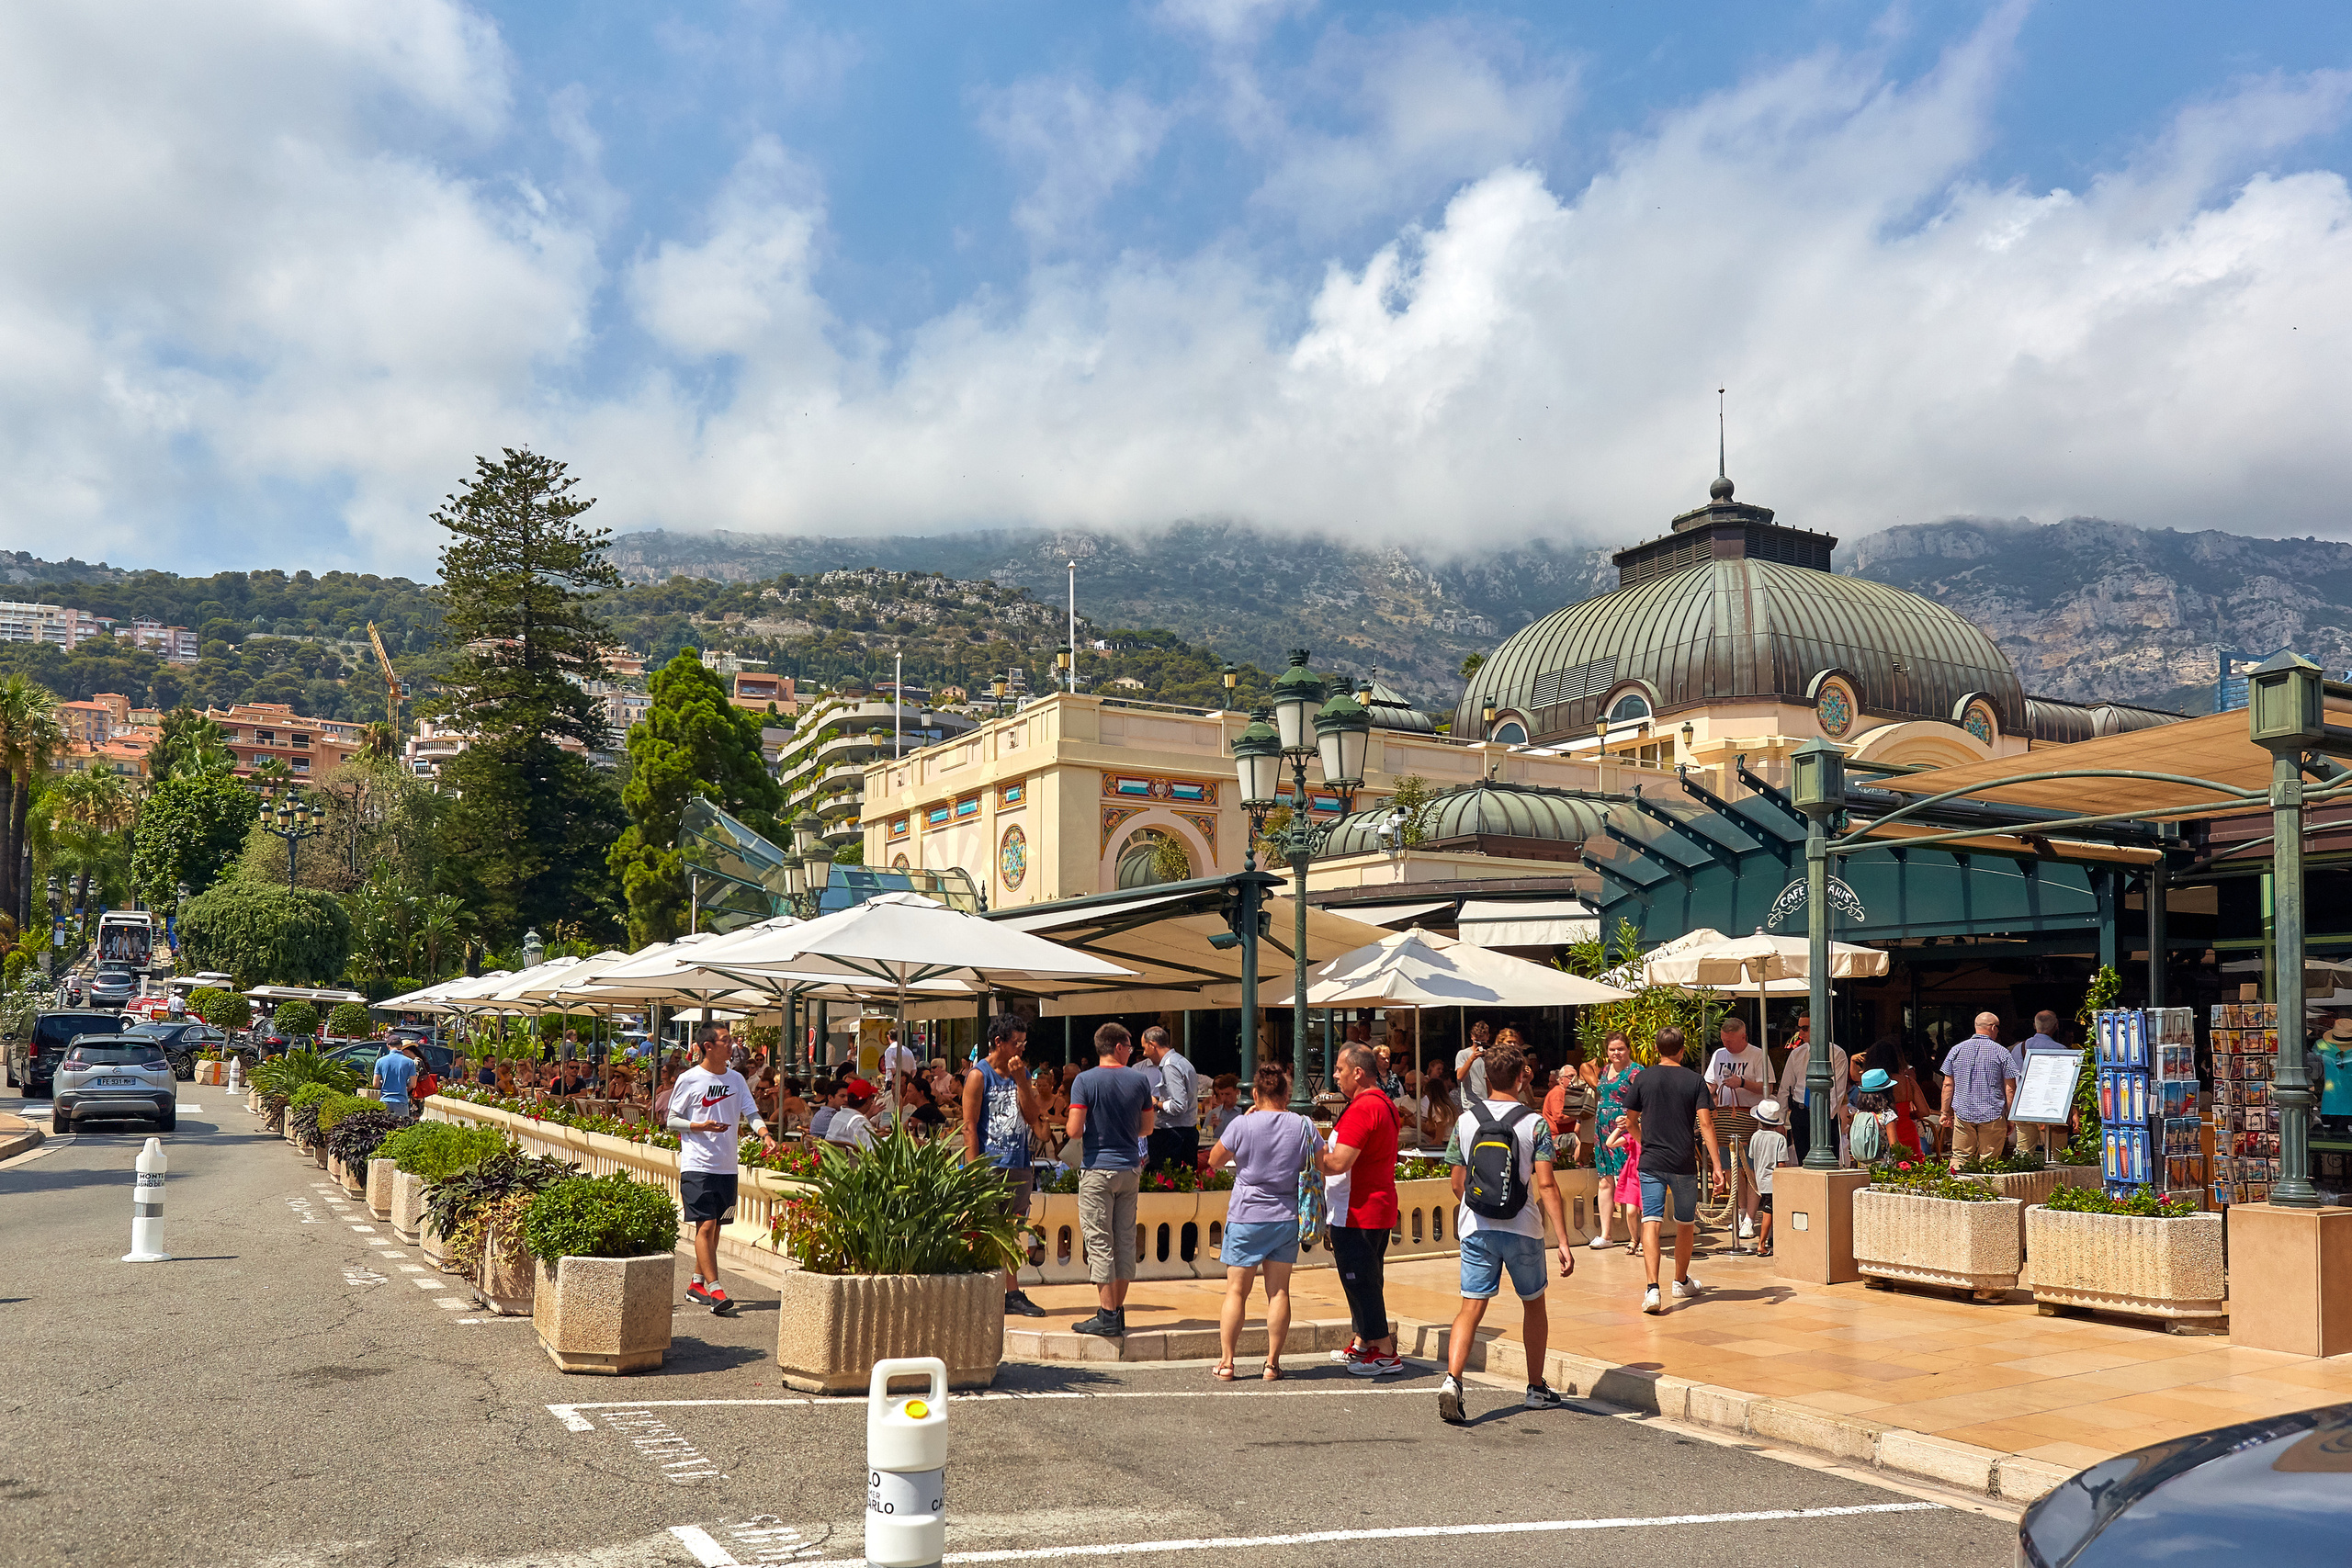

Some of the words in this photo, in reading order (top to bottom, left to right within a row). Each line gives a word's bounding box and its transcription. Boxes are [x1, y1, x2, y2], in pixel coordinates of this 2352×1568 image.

[1780, 886, 1805, 908] CAFE
[1827, 885, 1852, 903] ARIS
[1719, 1062, 1748, 1076] TMMY
[707, 1085, 730, 1098] NIKE
[1499, 1149, 1512, 1207] umbro
